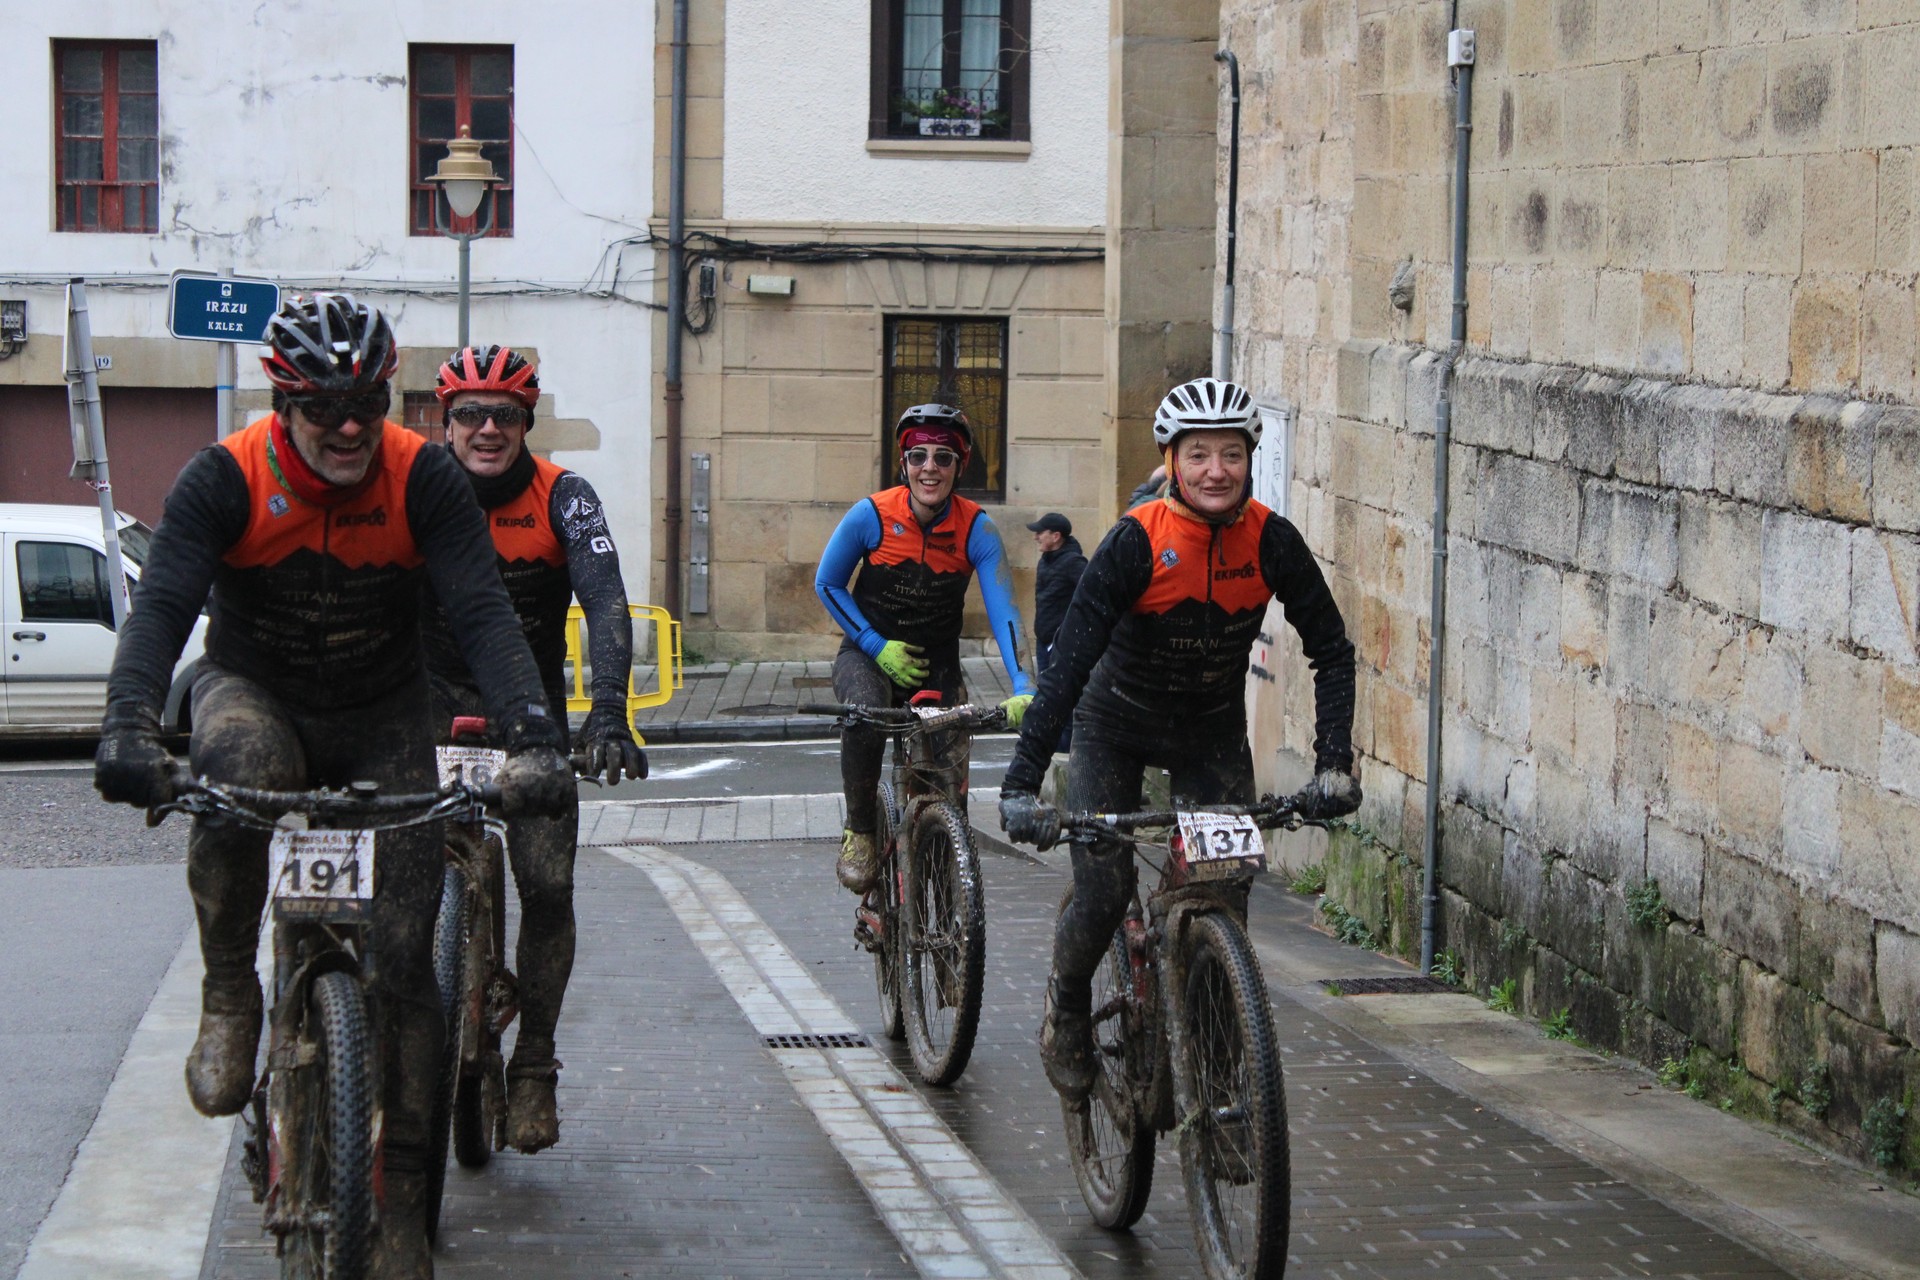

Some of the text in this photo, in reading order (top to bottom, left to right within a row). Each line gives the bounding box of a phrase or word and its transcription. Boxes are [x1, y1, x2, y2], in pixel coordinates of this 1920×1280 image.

[205, 301, 248, 315] IRAZU
[208, 321, 244, 332] KALEA
[97, 356, 110, 368] 19
[894, 583, 928, 597] TITAN
[282, 590, 339, 605] TITAN
[1169, 637, 1220, 650] TITAN
[1194, 828, 1254, 856] 137
[282, 859, 360, 892] 191
